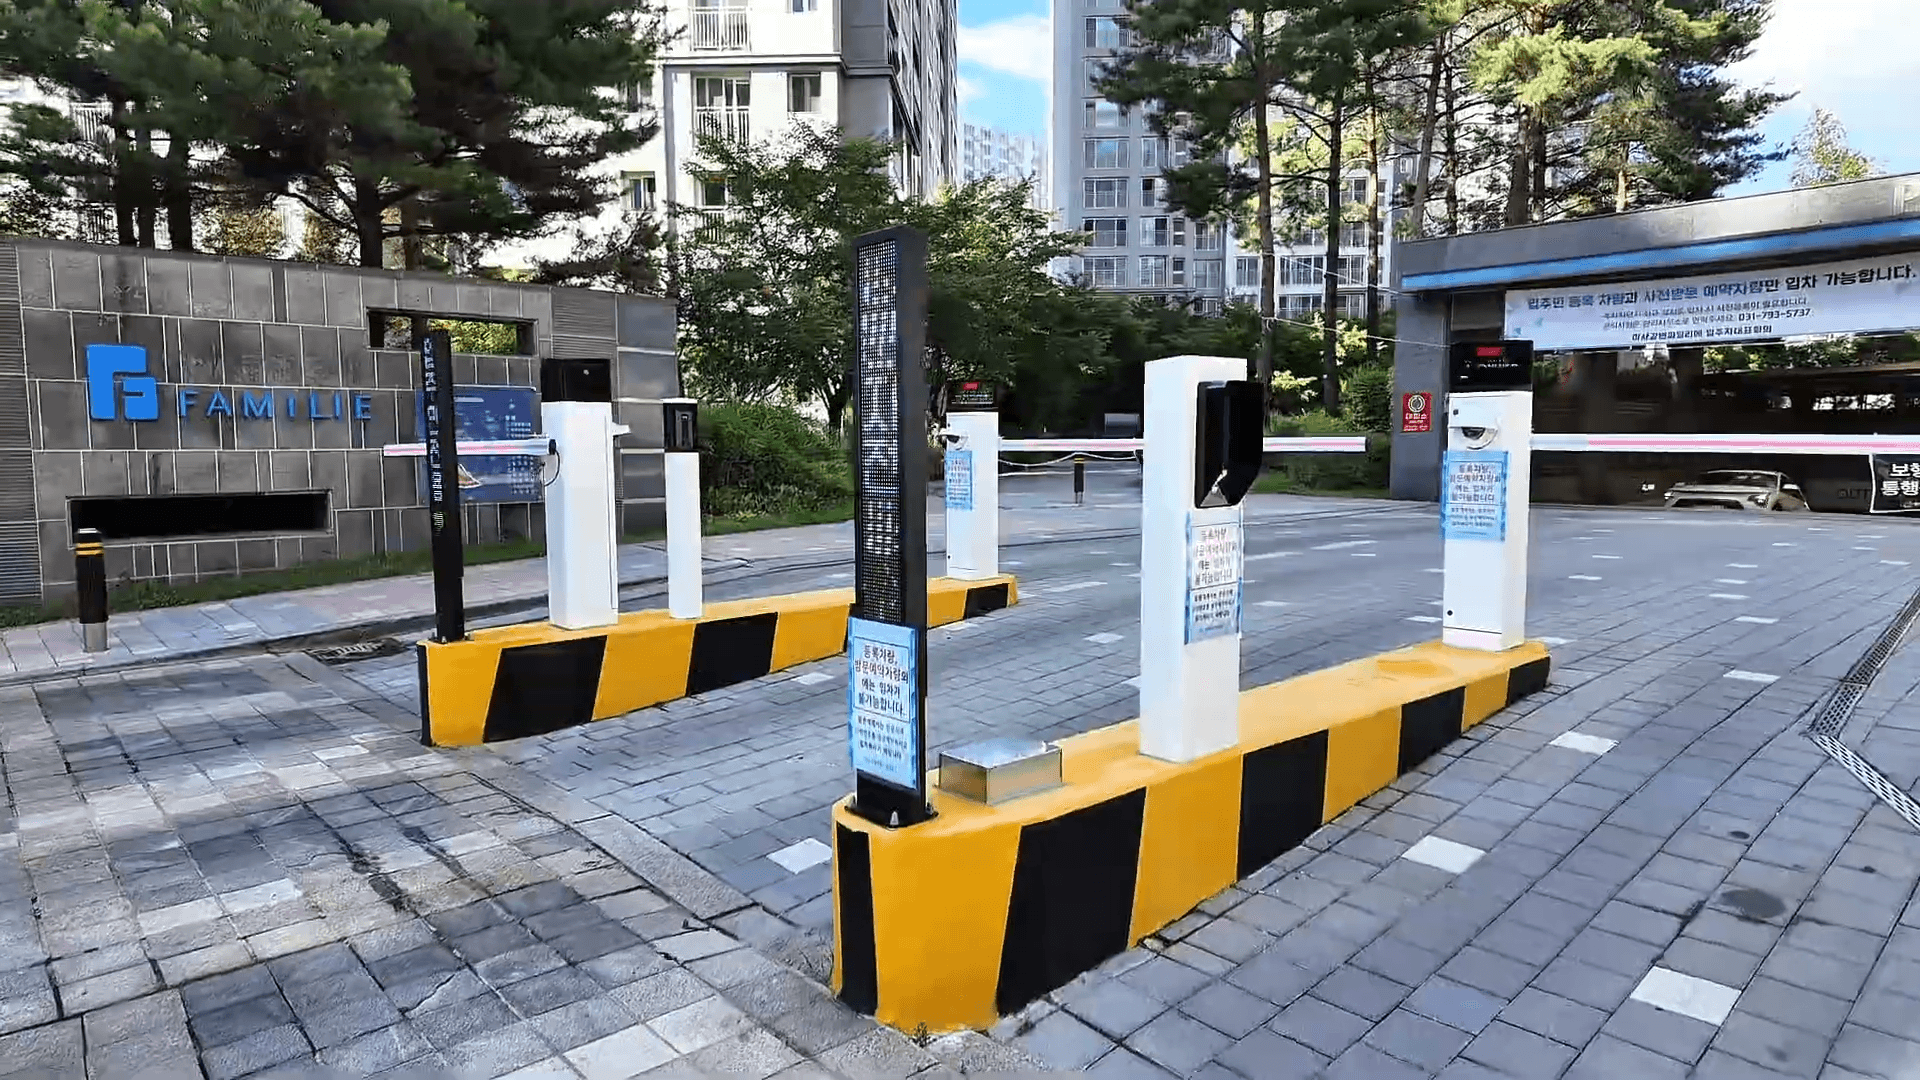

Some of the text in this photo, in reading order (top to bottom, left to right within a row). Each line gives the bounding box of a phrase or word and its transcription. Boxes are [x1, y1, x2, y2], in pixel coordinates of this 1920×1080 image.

[1703, 279, 1780, 297] 예약차량만
[1785, 275, 1818, 290] 입차
[1823, 264, 1917, 287] 가능합니다.
[1738, 308, 1811, 322] 031-793-5737
[178, 388, 373, 421] FAMILIE
[1880, 480, 1920, 496] 통행
